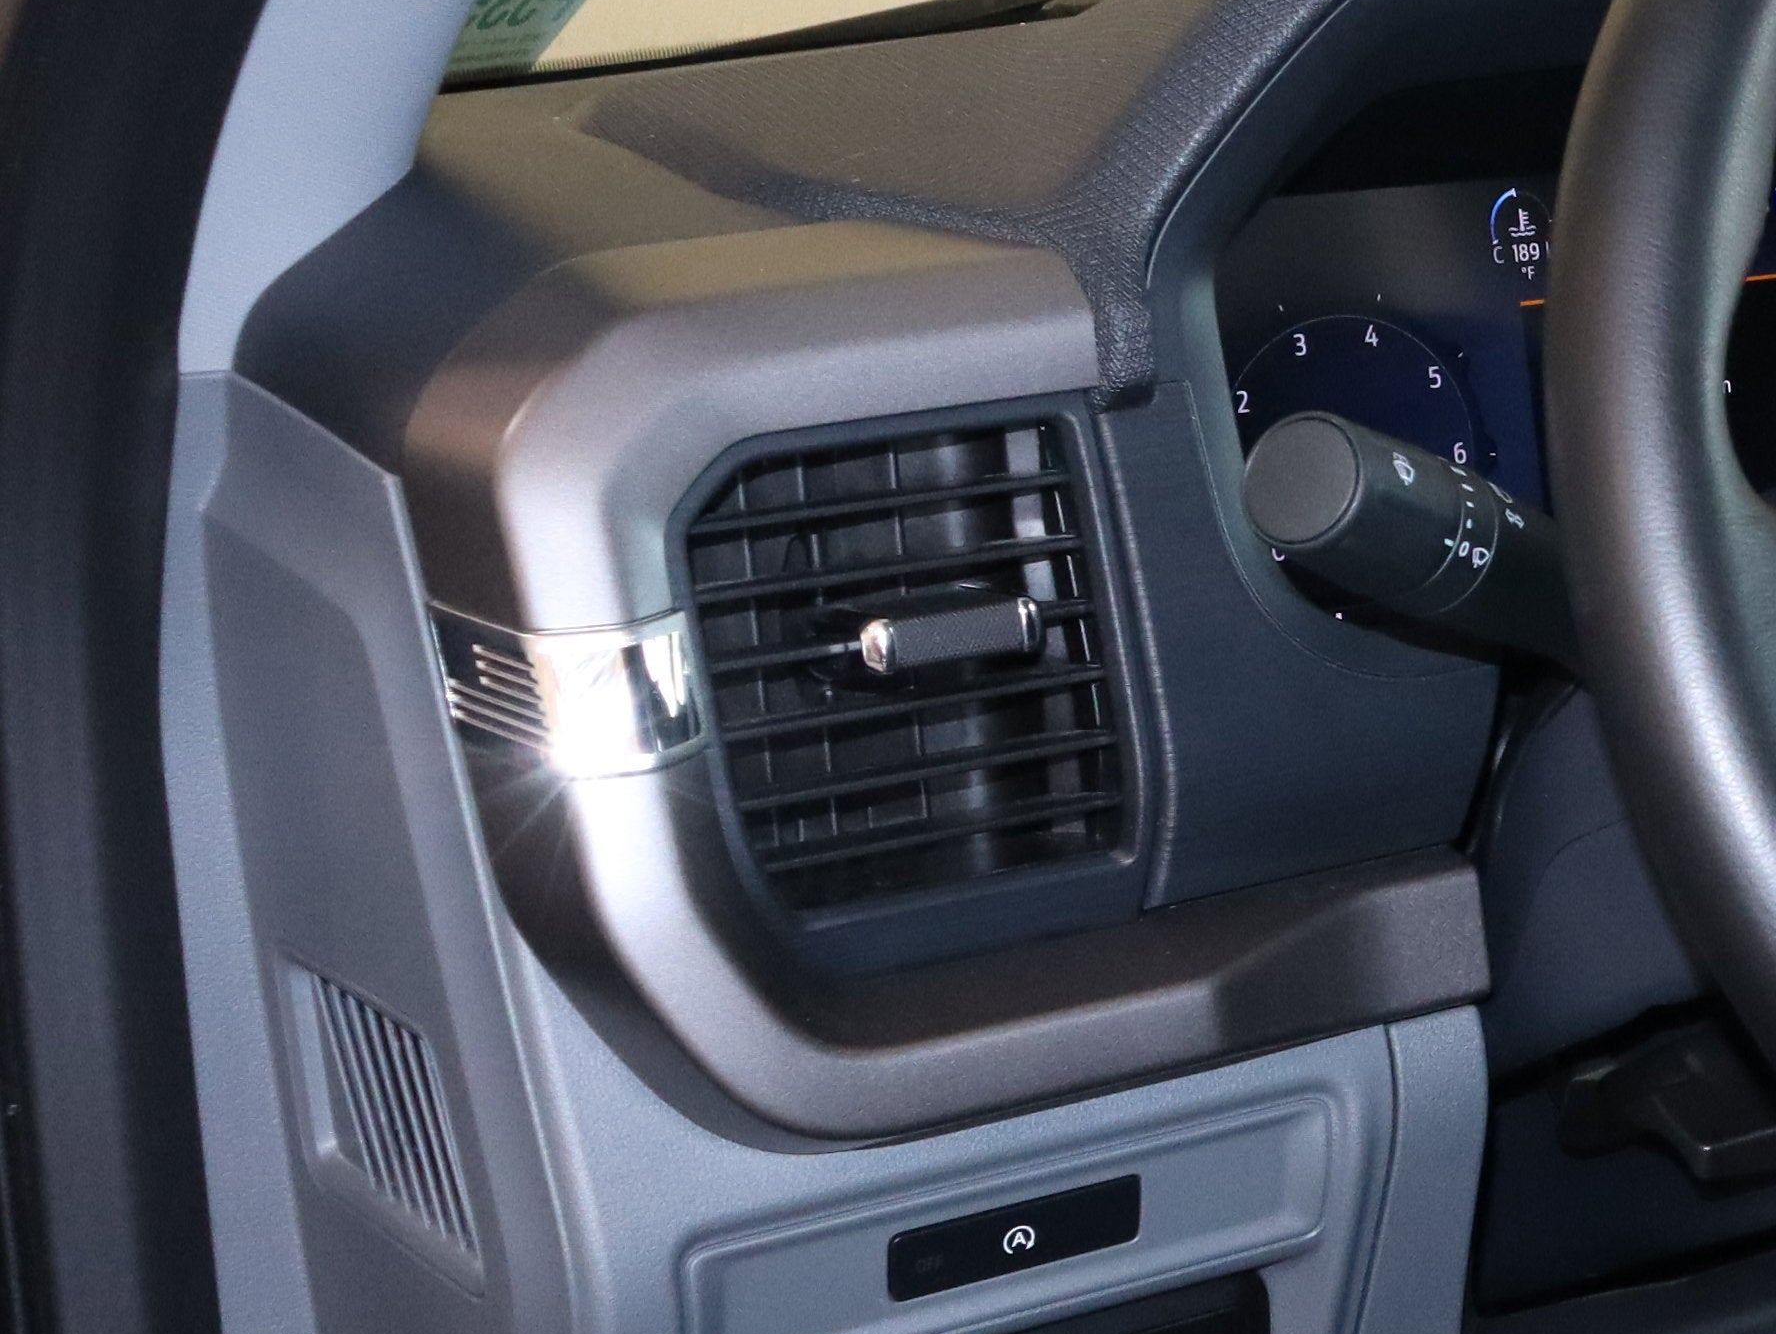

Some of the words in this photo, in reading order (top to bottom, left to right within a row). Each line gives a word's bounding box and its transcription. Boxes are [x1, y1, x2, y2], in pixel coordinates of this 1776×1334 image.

[1511, 242, 1540, 262] 189
[1293, 334, 1307, 356] 3
[1364, 325, 1379, 347] 4
[1428, 366, 1441, 389] 5
[1236, 391, 1249, 414] 2
[1453, 442, 1467, 464] 6
